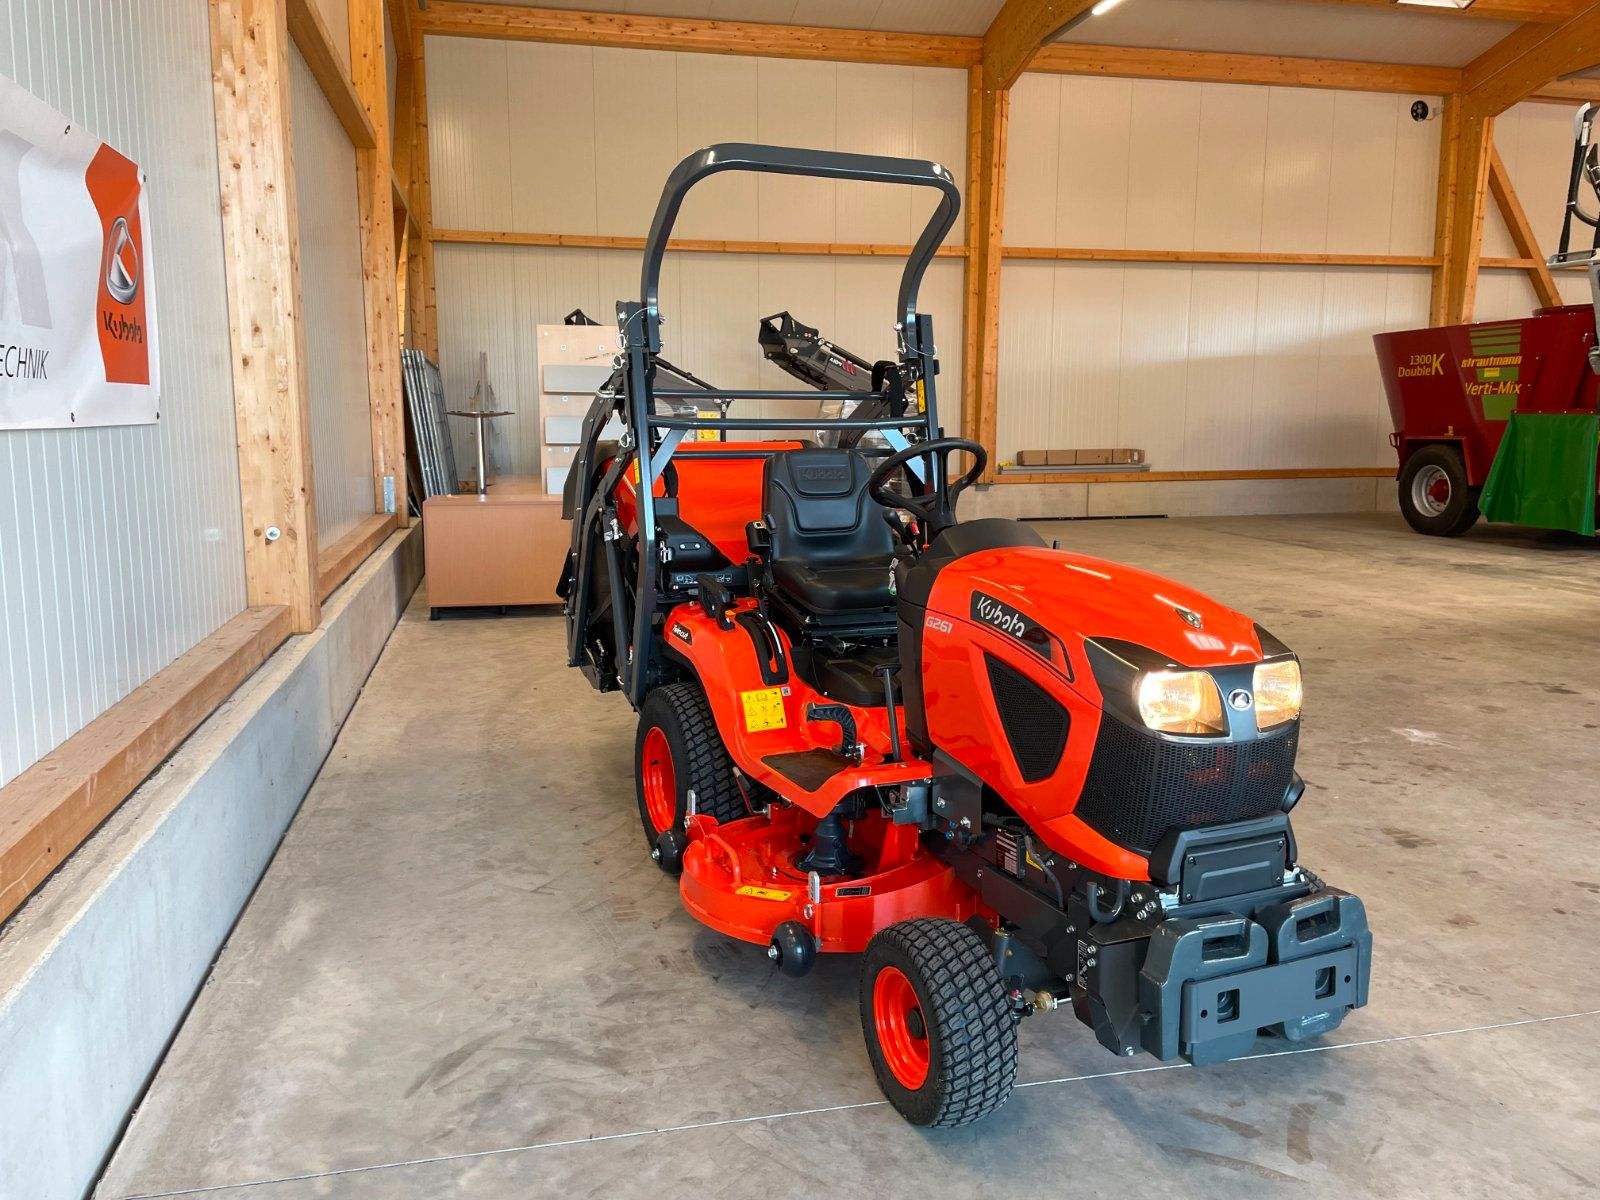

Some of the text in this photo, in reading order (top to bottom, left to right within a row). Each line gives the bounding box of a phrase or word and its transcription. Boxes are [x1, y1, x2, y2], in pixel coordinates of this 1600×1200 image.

[103, 310, 143, 343] Kubota
[1410, 354, 1432, 366] 1300
[1461, 355, 1522, 368] strautmann
[1398, 366, 1431, 378] Double
[1465, 380, 1522, 395] Verti-Mix
[977, 596, 1026, 638] Kubota
